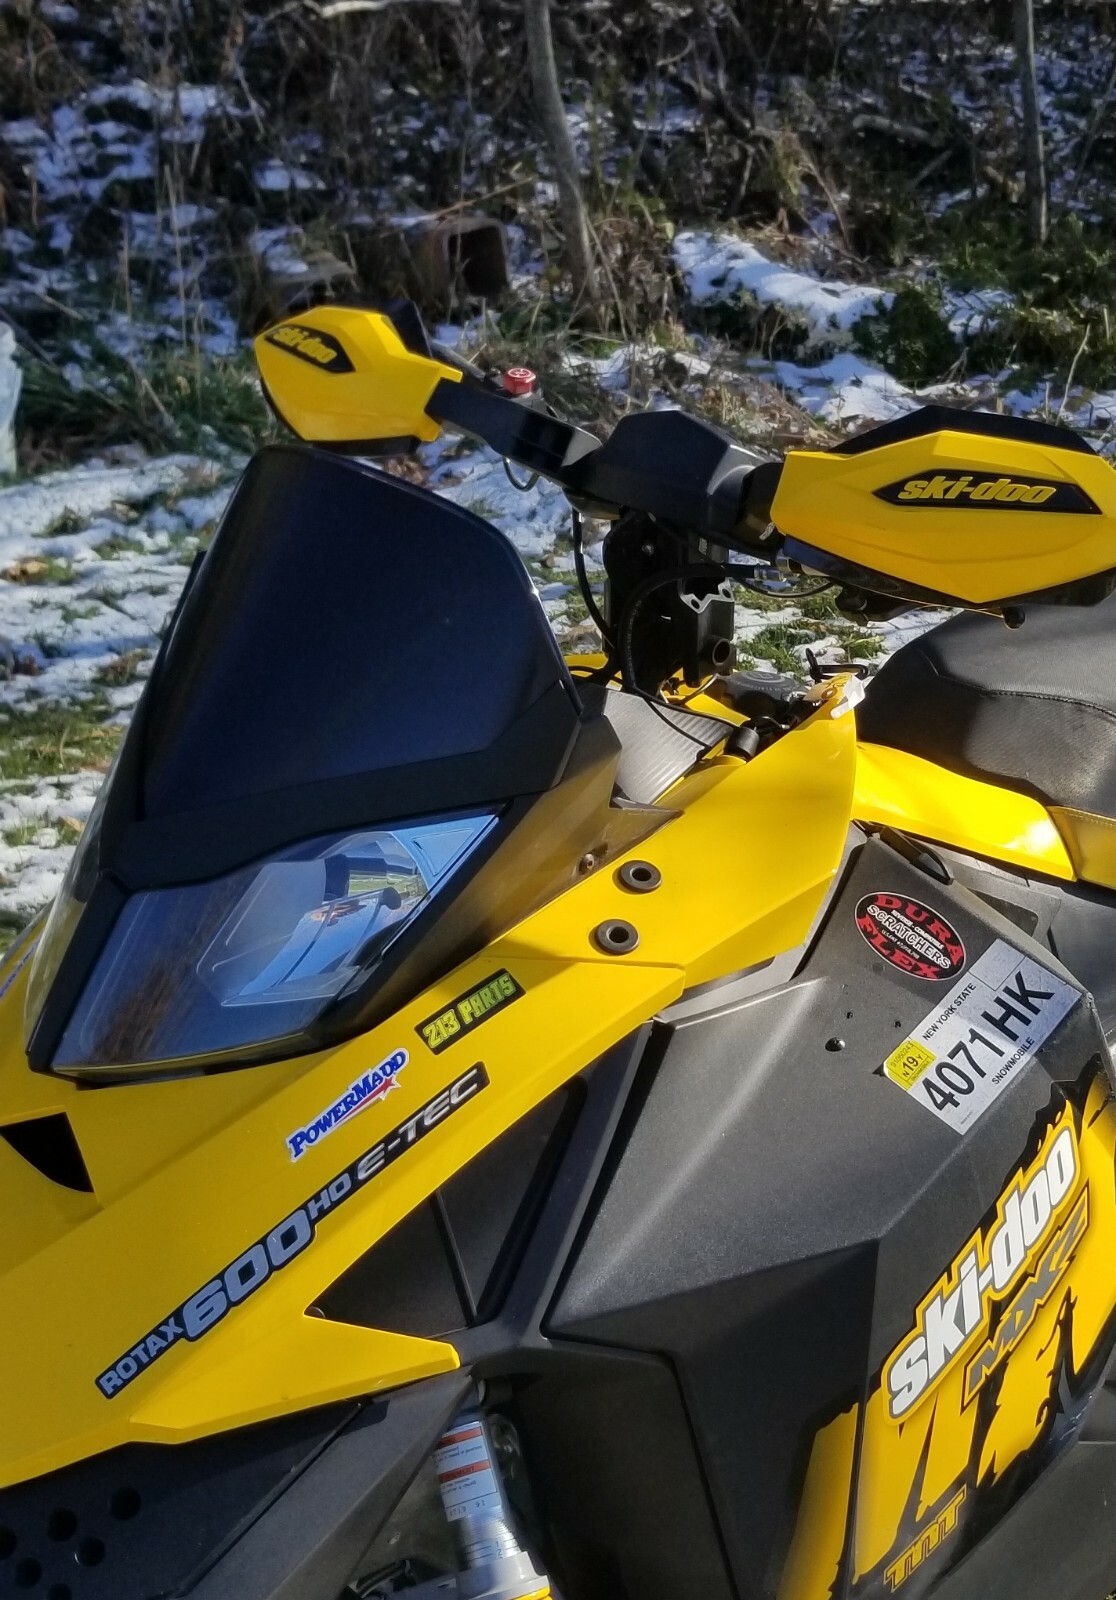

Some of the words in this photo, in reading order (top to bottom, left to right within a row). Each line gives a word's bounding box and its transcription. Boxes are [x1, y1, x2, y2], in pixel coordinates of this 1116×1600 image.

[857, 913, 940, 980] FLEX
[866, 904, 951, 969] SCRATCHERS
[874, 894, 964, 966] DURA
[422, 1008, 461, 1049] 213
[457, 972, 517, 1025] PARTS
[922, 1023, 940, 1041] NEW
[938, 1005, 957, 1026] YORK
[953, 982, 977, 1007] STATE
[922, 1027, 1005, 1111] 4071
[981, 970, 1055, 1042] HK
[902, 1056, 919, 1072] 19
[991, 1036, 1035, 1085] SNOWMOBILE
[99, 1317, 184, 1395] ROTAX
[182, 1209, 312, 1338] 600
[307, 1172, 352, 1220] HO
[357, 1068, 478, 1181] E-TEC
